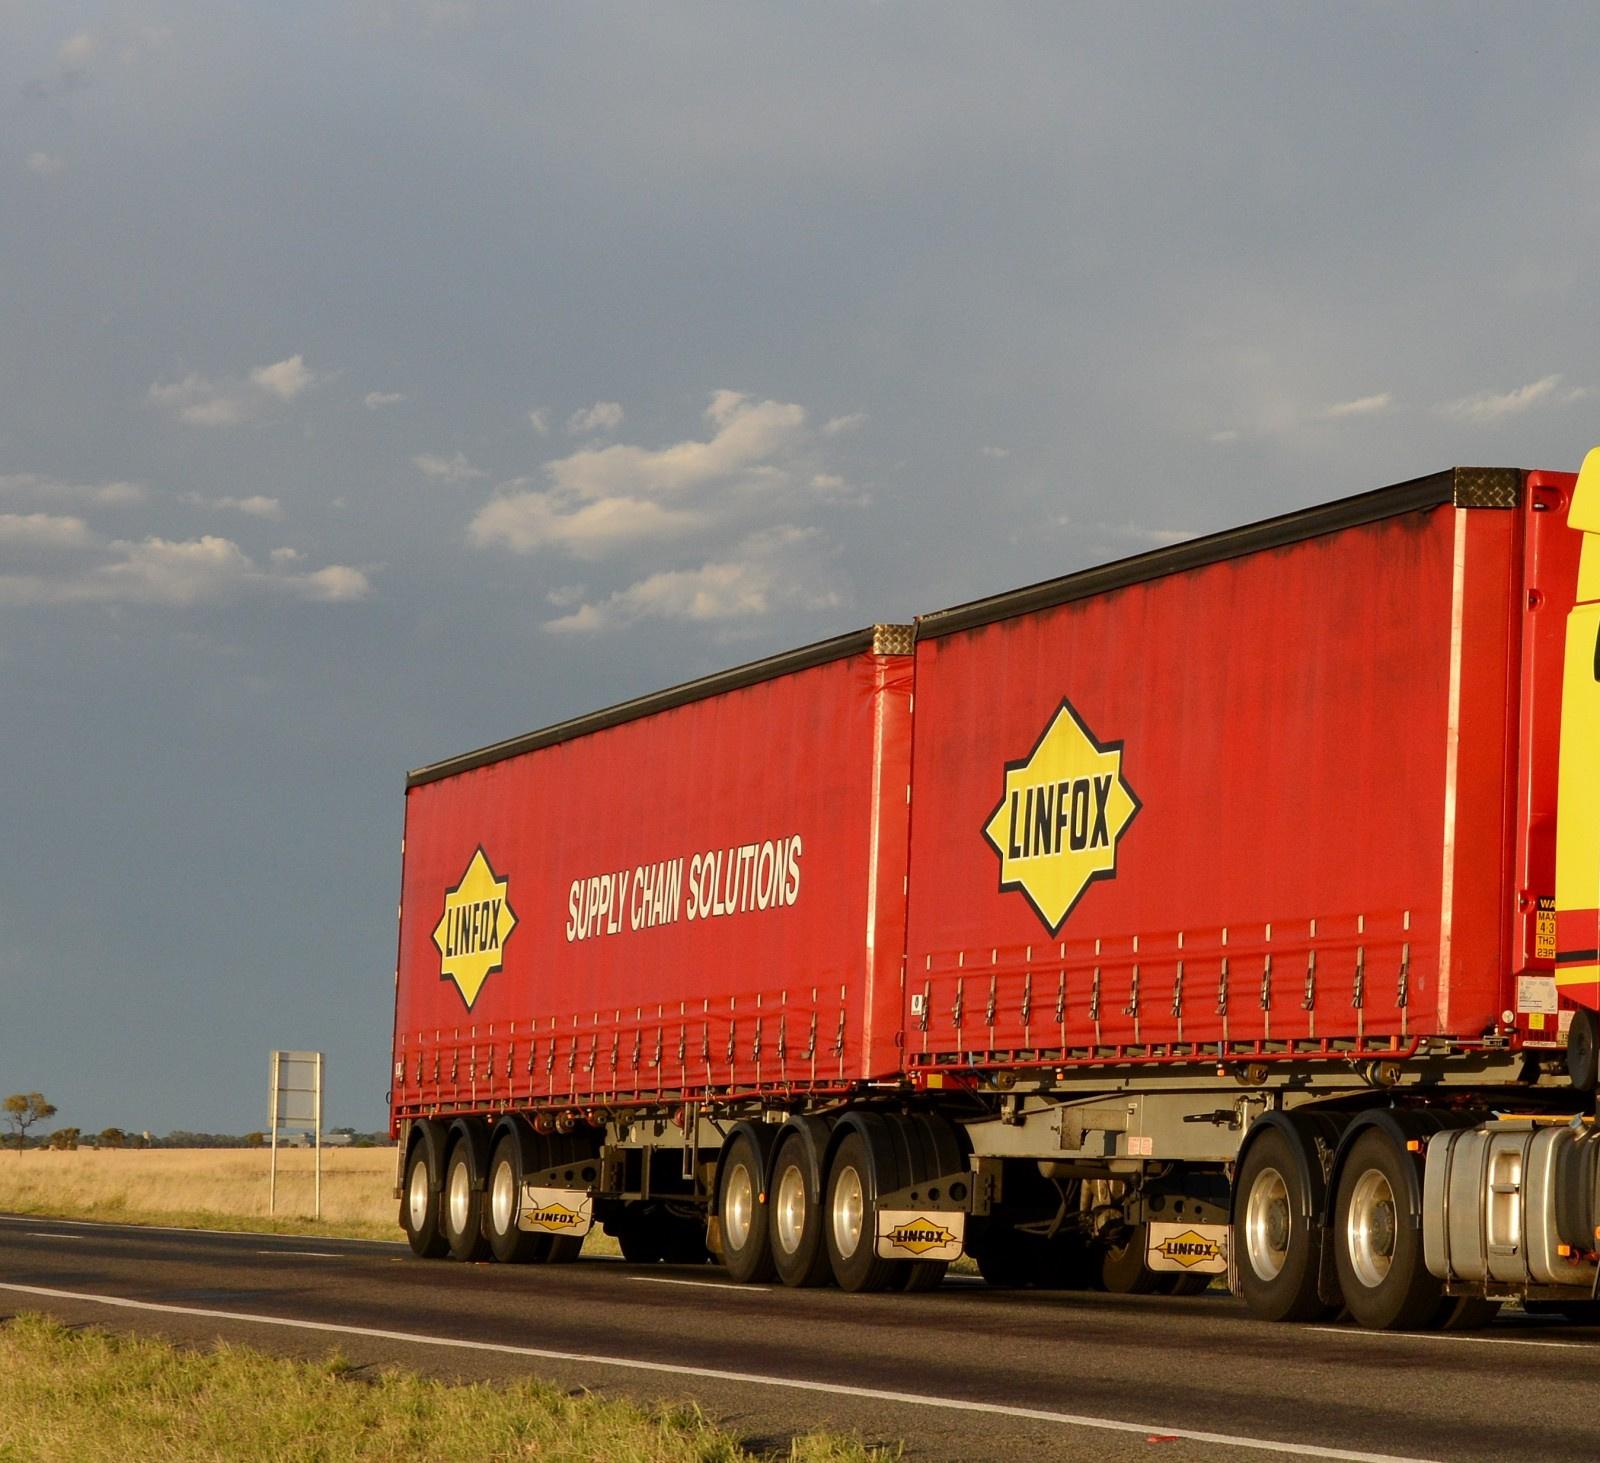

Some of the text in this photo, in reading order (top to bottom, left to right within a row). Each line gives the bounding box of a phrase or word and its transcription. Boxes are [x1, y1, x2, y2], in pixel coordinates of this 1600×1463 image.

[1008, 773, 1113, 860] LINFOX
[566, 834, 802, 942] SUPPLY CHAIN SOLUTIONS
[445, 898, 502, 957] LINFOX
[534, 1212, 576, 1224] LINFOX
[896, 1230, 945, 1243] LINFOX
[1167, 1242, 1213, 1256] LINFOX
